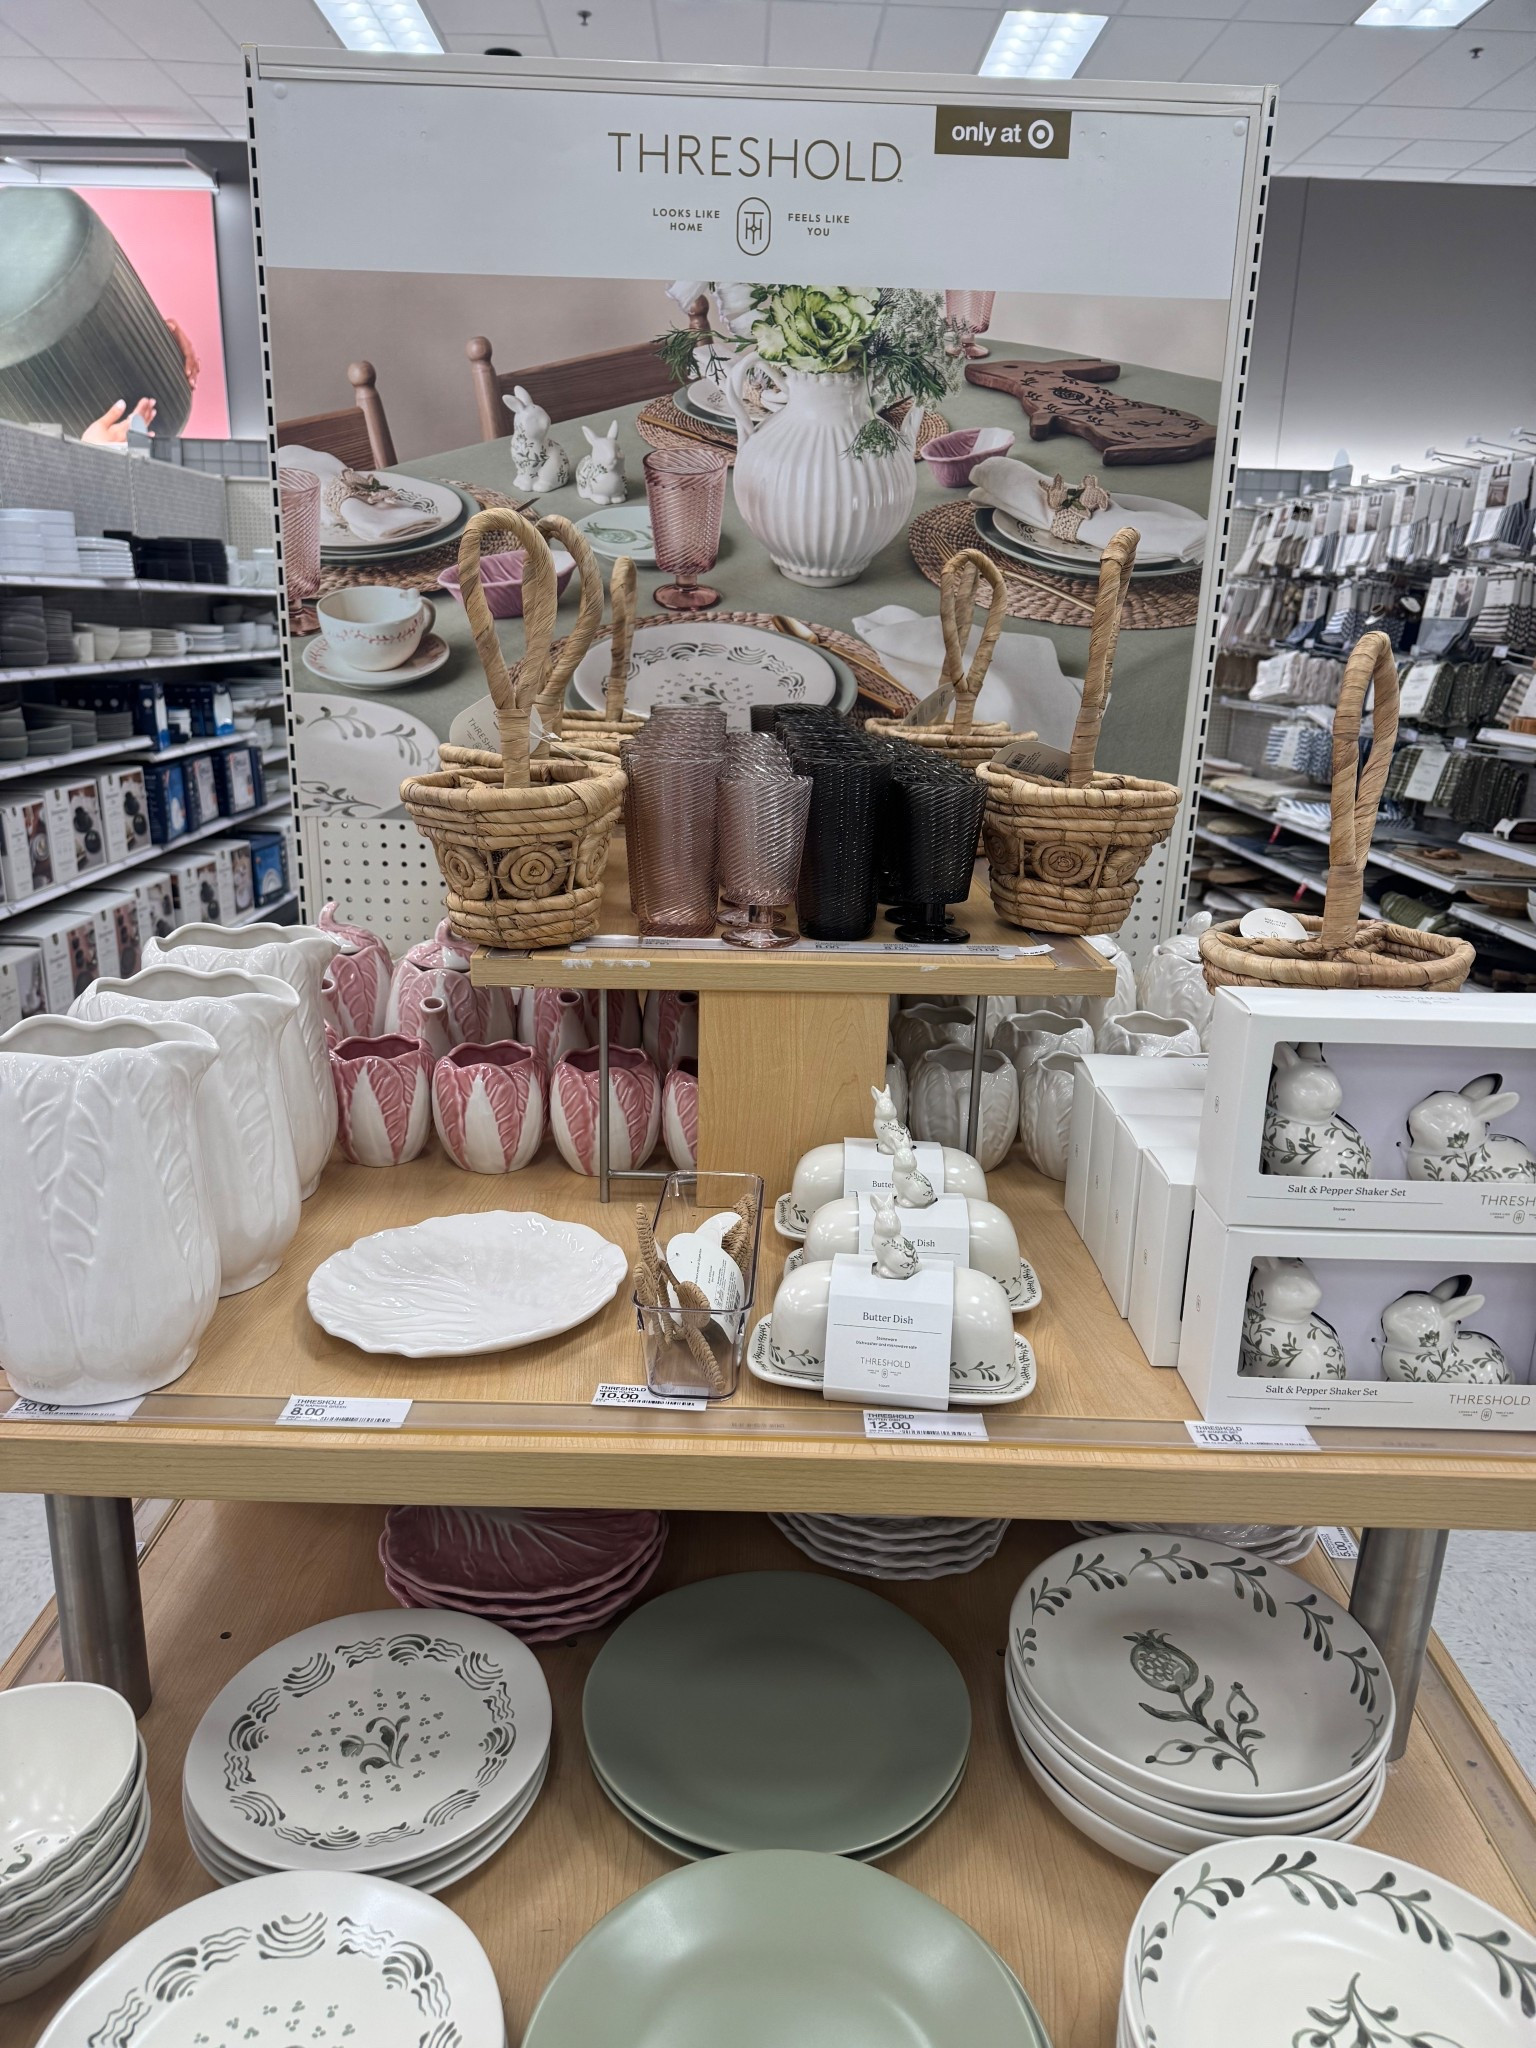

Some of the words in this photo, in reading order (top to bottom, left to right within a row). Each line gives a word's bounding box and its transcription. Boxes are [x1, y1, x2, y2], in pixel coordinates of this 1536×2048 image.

[952, 121, 997, 146] only
[1000, 123, 1022, 143] at
[607, 131, 902, 183] THRESHOLD
[652, 207, 691, 218] LOOKS
[695, 208, 721, 219] LIKE
[787, 212, 821, 223] FEELS
[825, 214, 850, 224] LIKE
[669, 222, 703, 232] HOME
[807, 227, 830, 236] YOU
[468, 718, 498, 754] THRESHO
[1287, 1183, 1307, 1194] Salt
[1309, 1185, 1318, 1195] &
[1319, 1185, 1354, 1196] Pepper
[1355, 1186, 1389, 1197] Shaker
[1390, 1187, 1407, 1197] Set
[1480, 1194, 1536, 1207] THRESH
[916, 1239, 936, 1248] Dish
[862, 1311, 892, 1323] Butter
[893, 1314, 914, 1325] Dish
[860, 1356, 911, 1369] THRESHOLD
[599, 1392, 639, 1400] 10.00
[1264, 1384, 1284, 1394] Salt
[1285, 1385, 1294, 1394] &
[1295, 1385, 1328, 1396] Pepper
[1329, 1386, 1362, 1396] Shaker
[1362, 1387, 1379, 1396] Set
[1449, 1394, 1531, 1406] THRESHOLD
[14, 1402, 61, 1412] 20.00
[290, 1407, 326, 1416] 8.00
[869, 1421, 911, 1430] 12.00
[1199, 1433, 1243, 1442] 10.00
[1334, 1541, 1352, 1557] 5.00
